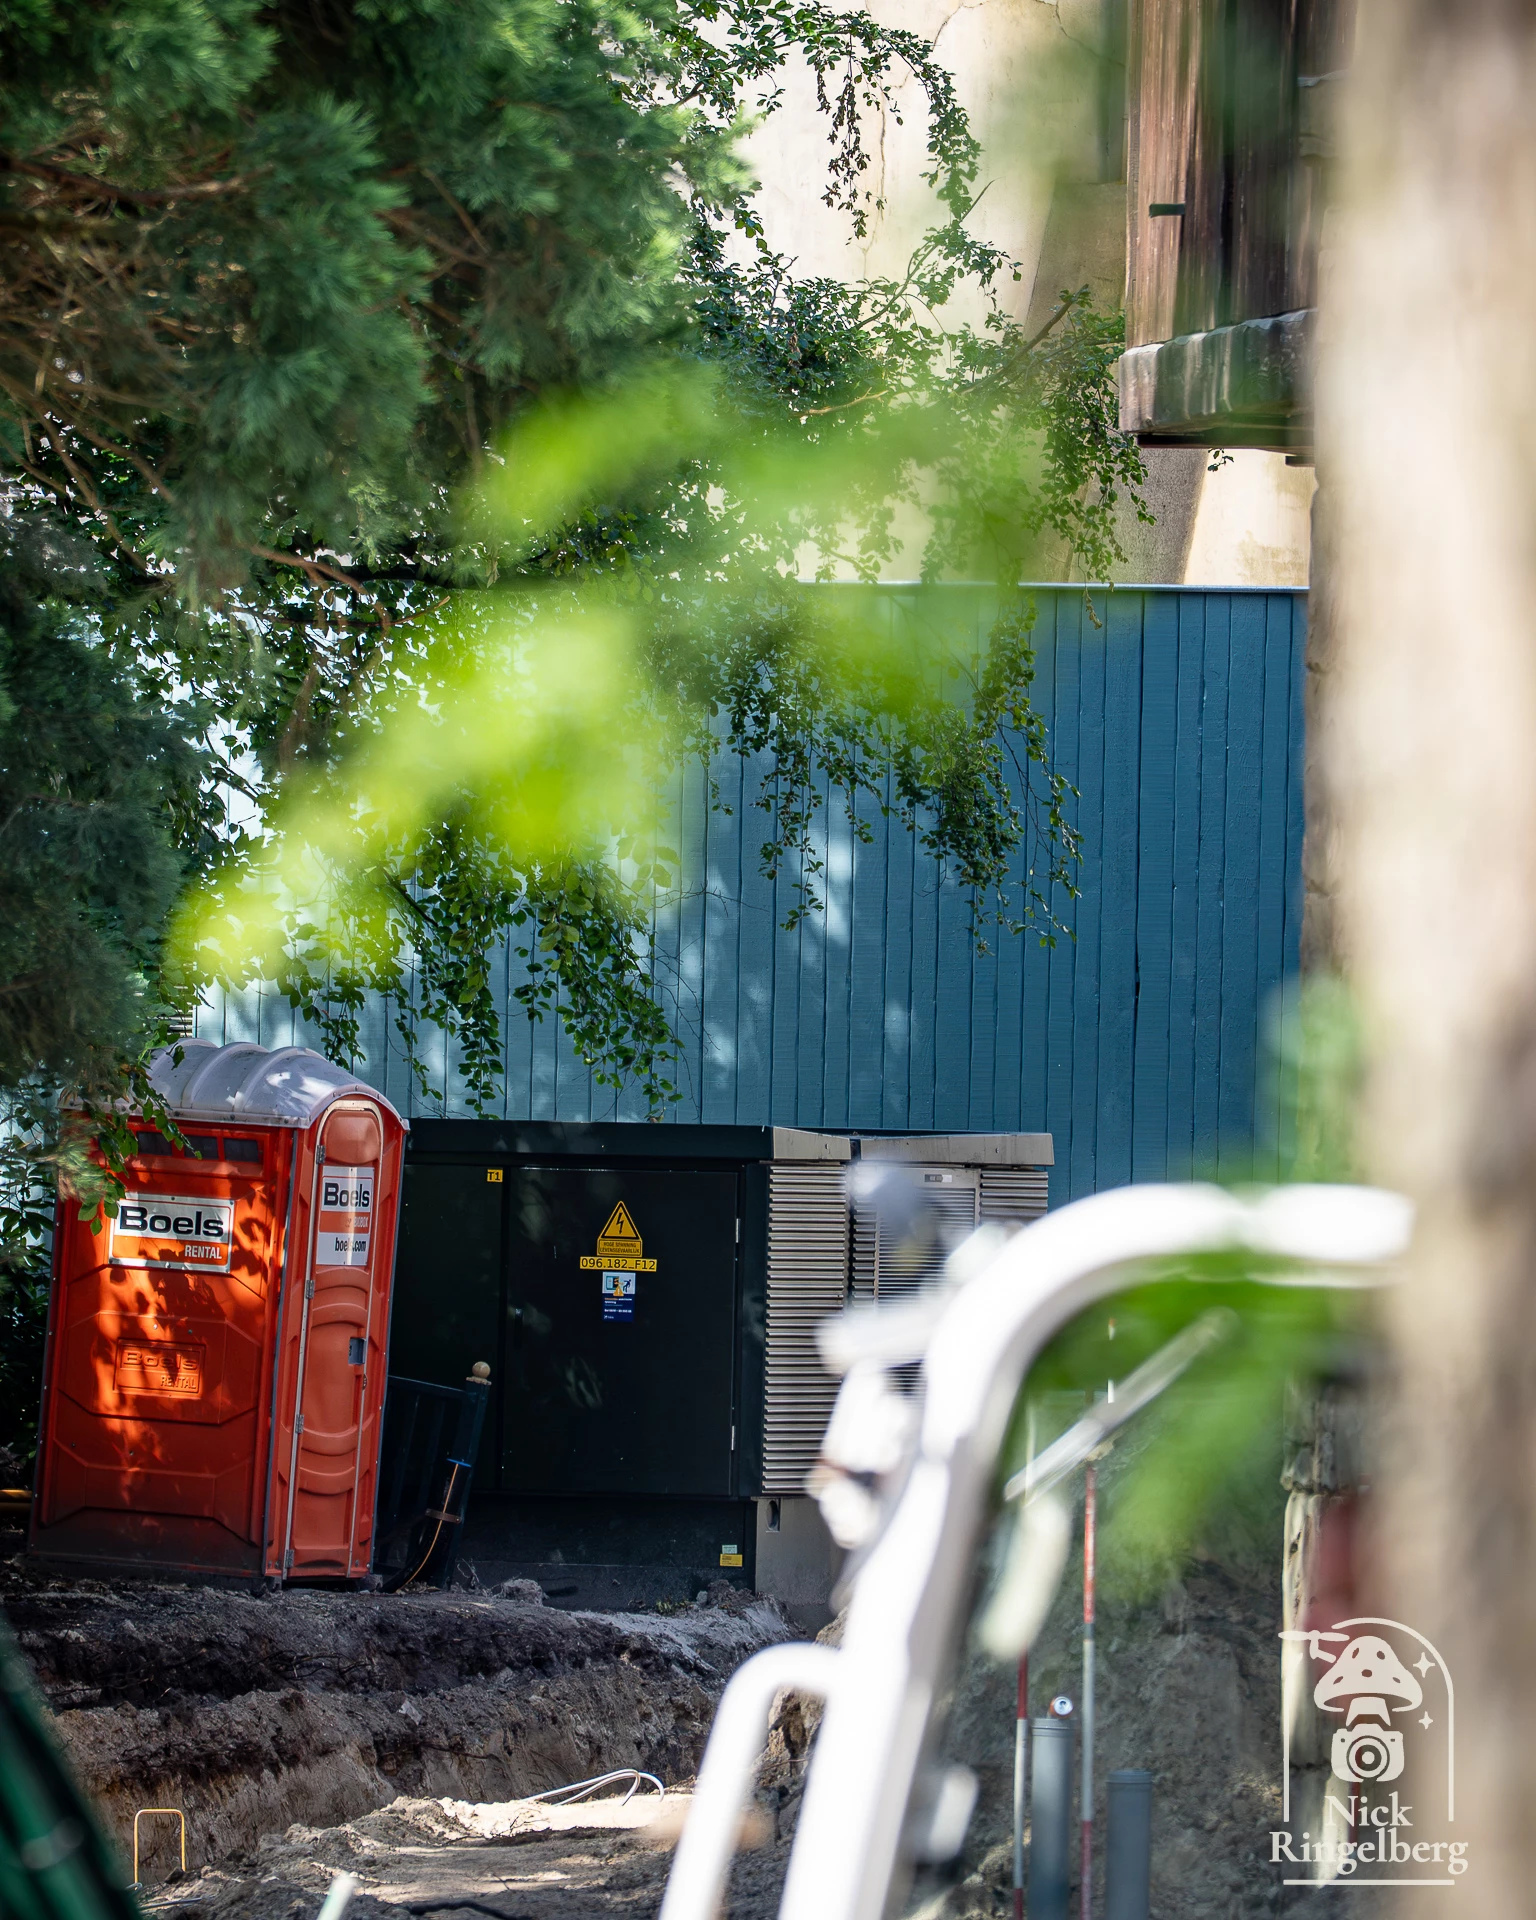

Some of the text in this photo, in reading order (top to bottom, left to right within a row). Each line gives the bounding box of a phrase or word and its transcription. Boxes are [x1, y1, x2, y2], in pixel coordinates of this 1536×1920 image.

[487, 1172, 501, 1181] T1
[324, 1182, 370, 1208] Boels
[119, 1206, 224, 1238] Boels
[184, 1244, 222, 1259] RENTAL
[334, 1237, 367, 1252] boe.com
[122, 1350, 198, 1370] Boels
[160, 1375, 197, 1389] RENTAL
